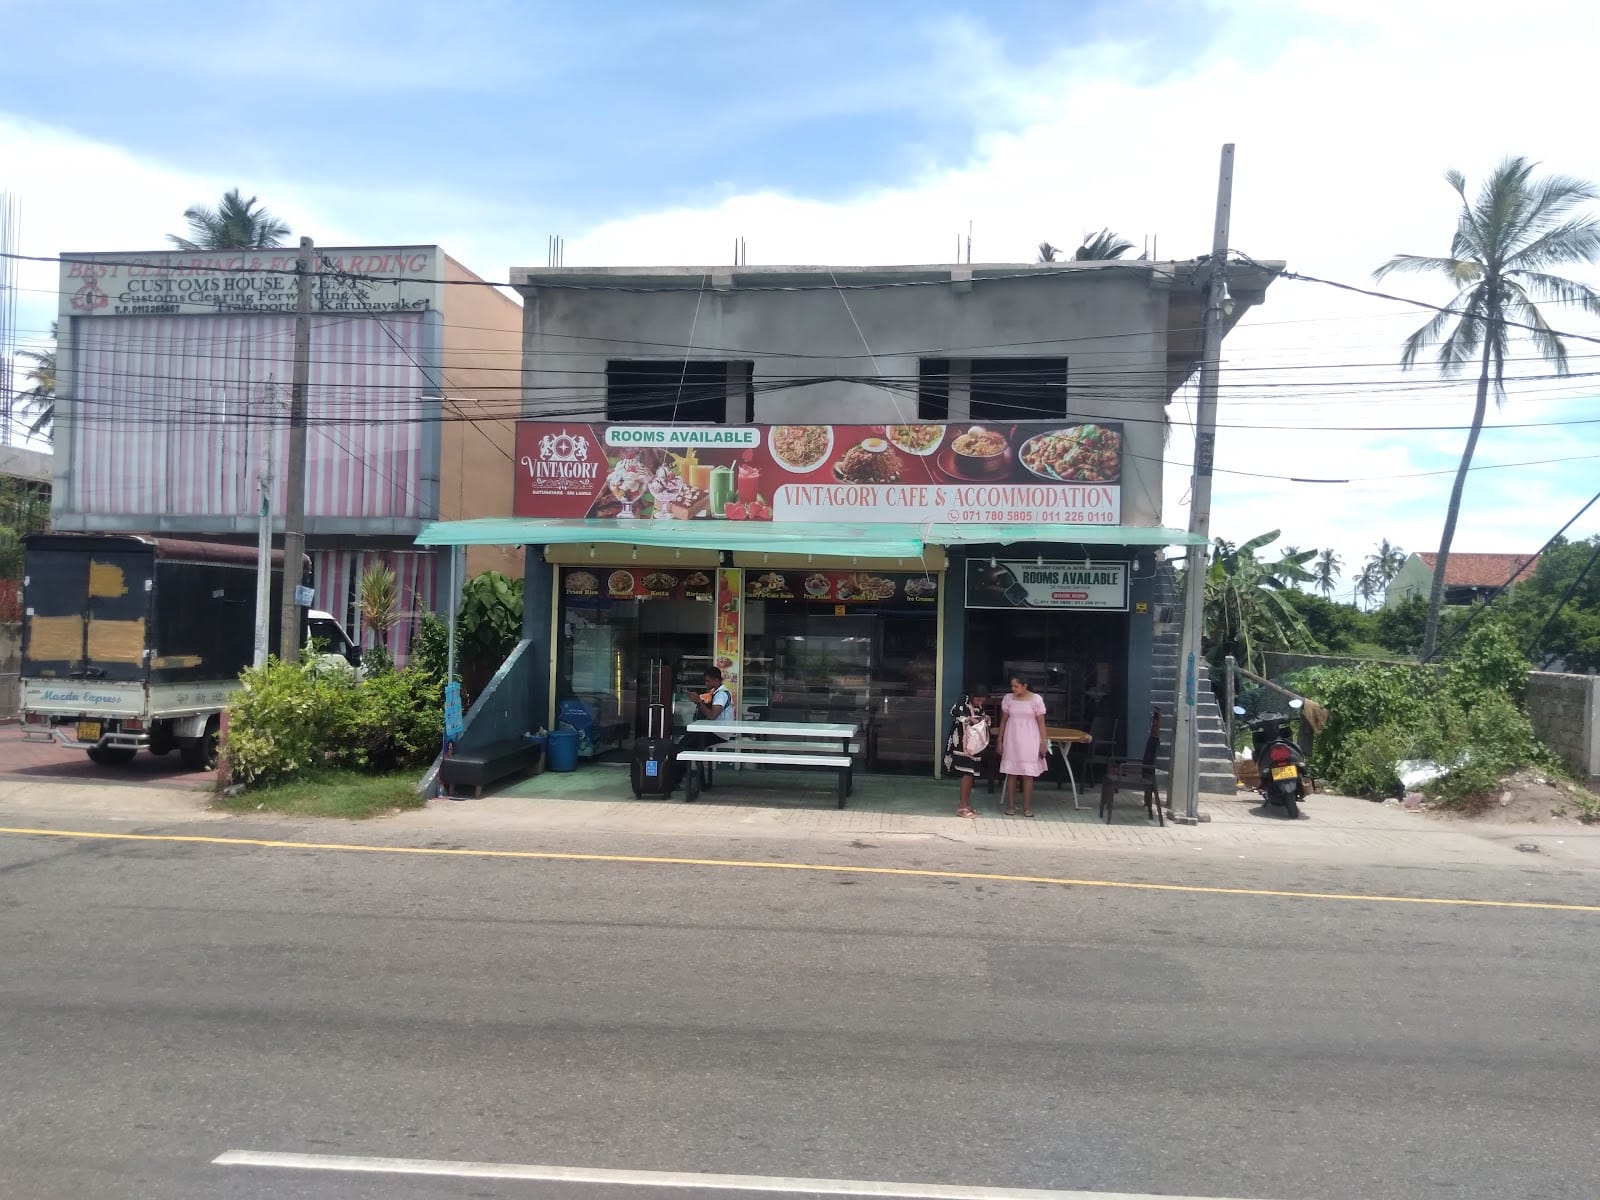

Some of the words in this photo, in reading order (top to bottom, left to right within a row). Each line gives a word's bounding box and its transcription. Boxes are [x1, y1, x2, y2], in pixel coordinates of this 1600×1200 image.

[68, 260, 119, 279] BEST
[126, 257, 245, 278] CLEARING
[250, 257, 262, 271] &
[271, 254, 428, 273] FOWARDING
[127, 279, 220, 293] CUSTOMS
[224, 277, 284, 291] HOUSE
[119, 292, 186, 304] Customs
[188, 290, 254, 305] Clearing
[258, 289, 348, 303] Forwding
[358, 288, 370, 300] &
[320, 298, 423, 312] Katunayake
[611, 430, 665, 443] ROOMS
[669, 430, 753, 443] AVAILABLE
[521, 455, 599, 479] VINTAGORY
[784, 486, 879, 507] VINTAGORY
[886, 486, 928, 507] CAFE
[935, 490, 948, 507] &
[953, 486, 1113, 509] ACCOMMODATION
[963, 511, 981, 521] 071
[985, 511, 1003, 521] 780
[1007, 511, 1032, 521] 5805
[1042, 511, 1060, 521] 011
[1065, 511, 1083, 522] 226
[1087, 511, 1113, 522] 0110
[1022, 572, 1059, 584] ROOMS
[1062, 572, 1119, 585] AVAILABLE
